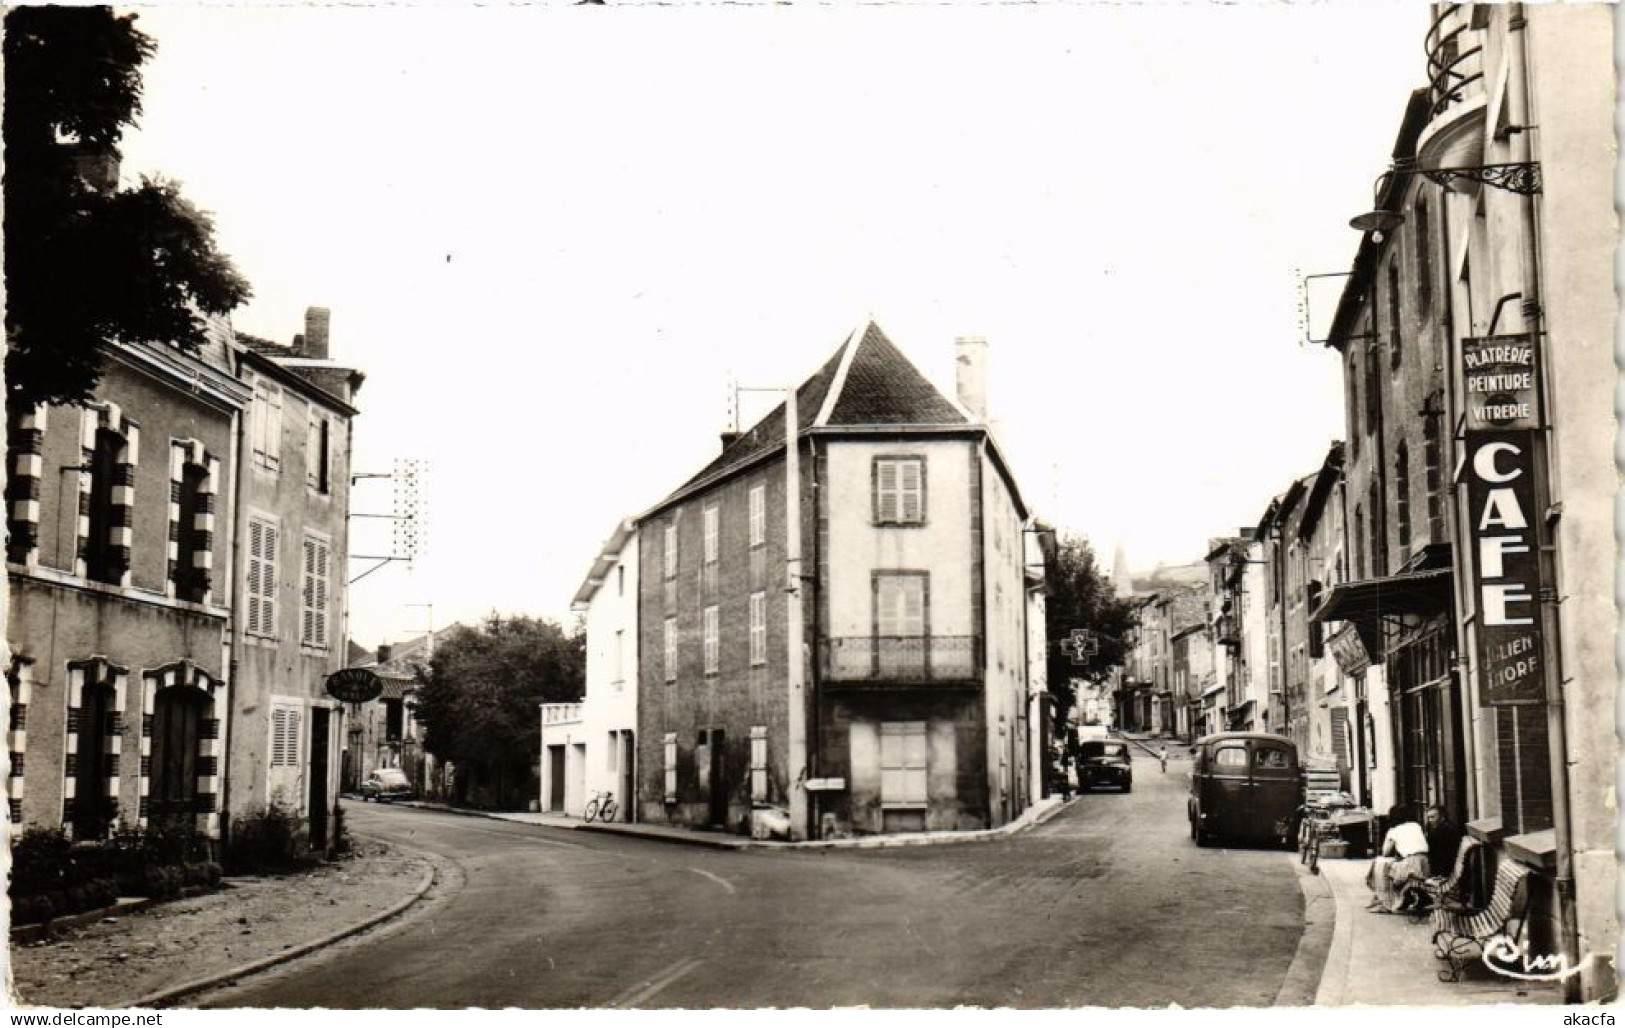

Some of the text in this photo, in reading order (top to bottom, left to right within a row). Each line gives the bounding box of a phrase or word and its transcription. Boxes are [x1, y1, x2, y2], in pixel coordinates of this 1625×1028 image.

[1465, 344, 1532, 368] PLATRERIE
[1468, 373, 1531, 392] PEINTURE
[1473, 403, 1530, 420] VITRERIE
[1473, 441, 1534, 625] CAFE
